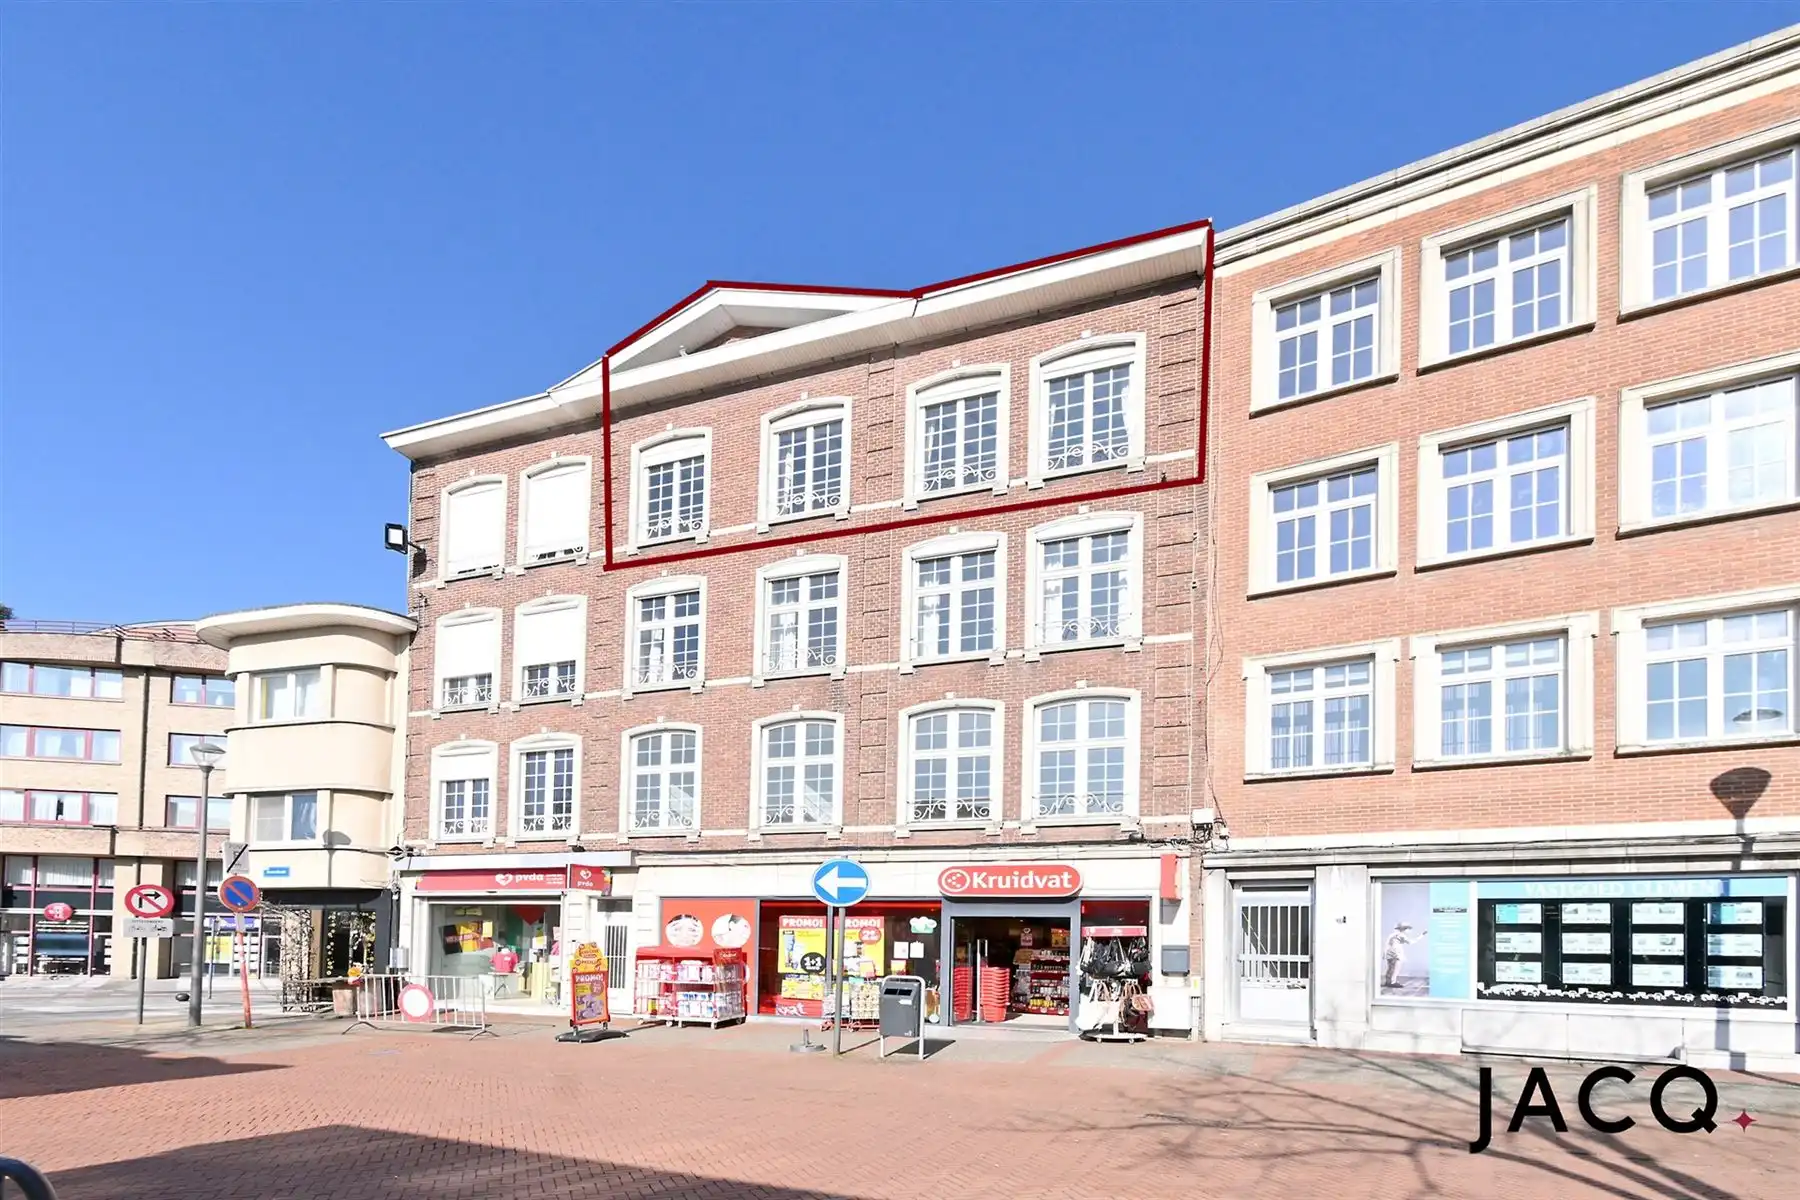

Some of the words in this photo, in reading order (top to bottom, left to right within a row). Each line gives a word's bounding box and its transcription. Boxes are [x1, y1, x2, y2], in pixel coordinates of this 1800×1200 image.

[515, 873, 545, 883] pvda
[972, 870, 1073, 889] Kruidvat
[782, 917, 823, 928] PROMO!
[838, 917, 881, 928] ROMO!
[804, 956, 823, 967] 1+1
[575, 973, 604, 982] PROMO!
